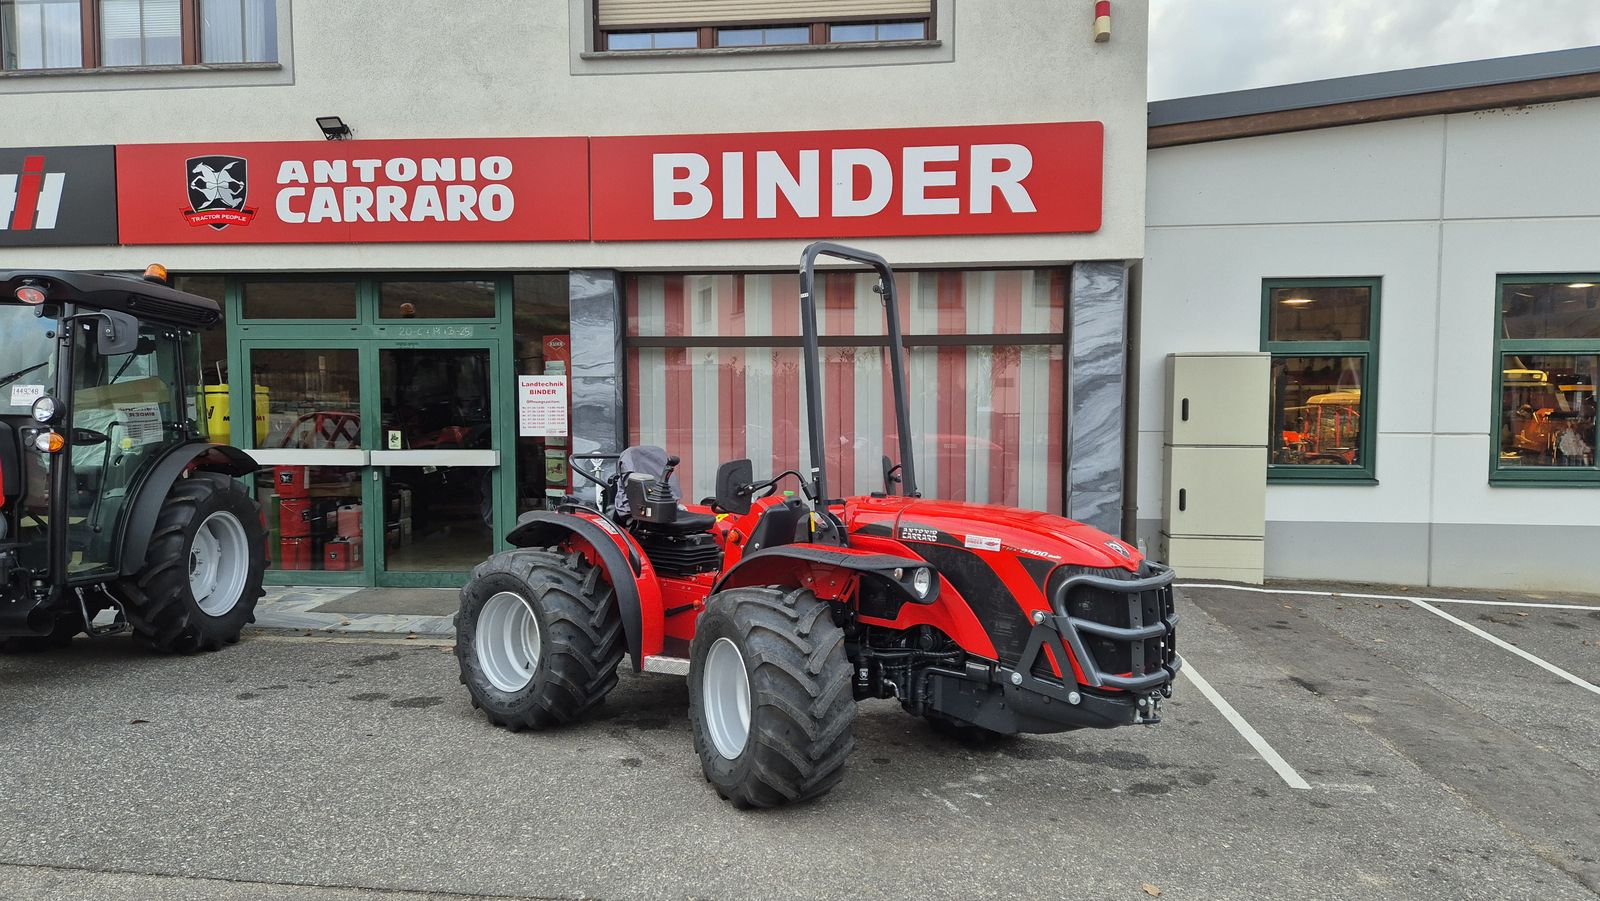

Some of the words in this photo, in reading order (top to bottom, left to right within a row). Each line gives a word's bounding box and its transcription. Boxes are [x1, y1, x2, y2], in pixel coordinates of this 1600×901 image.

[276, 156, 513, 184] ANTONIO
[653, 143, 1038, 220] BINDER
[275, 184, 515, 223] CARRARO
[191, 213, 221, 223] TRACTOR
[221, 213, 247, 222] PEOPLE
[902, 532, 938, 542] CARRARO
[903, 527, 938, 535] ANTONIO
